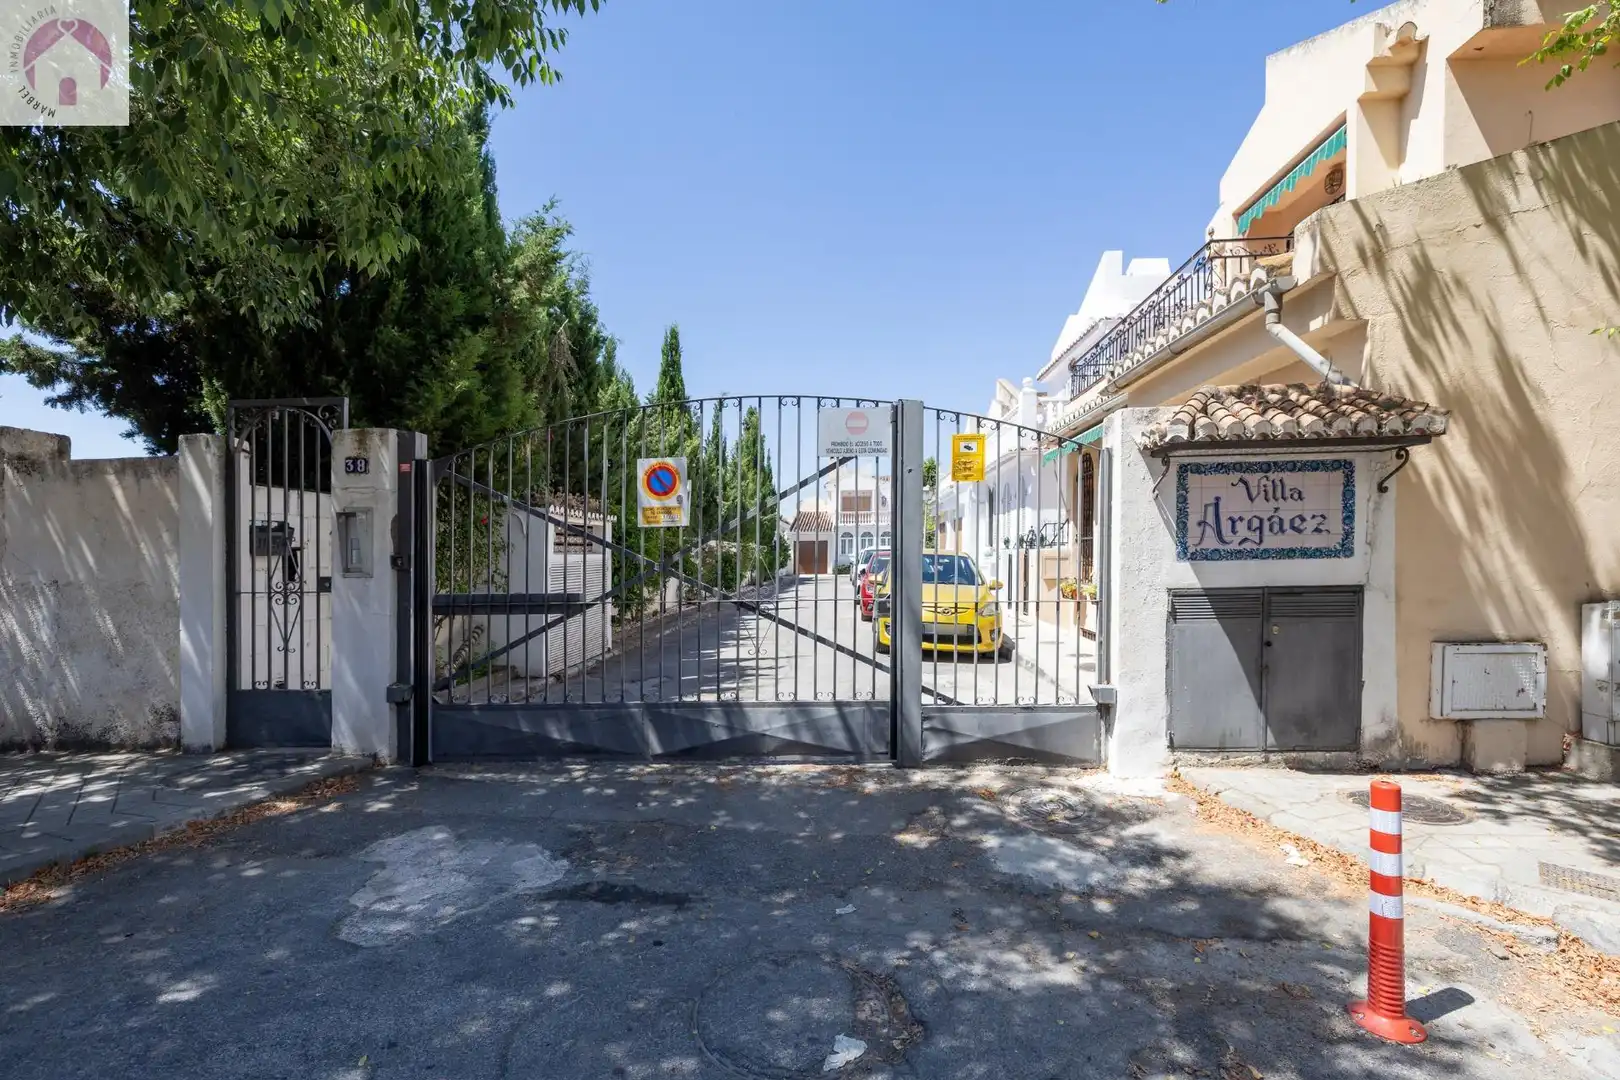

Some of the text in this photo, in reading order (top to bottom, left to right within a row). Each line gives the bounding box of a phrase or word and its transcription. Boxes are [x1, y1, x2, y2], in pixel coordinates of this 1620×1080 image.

[345, 459, 366, 472] 38
[1231, 475, 1305, 504] Villa
[1193, 496, 1331, 547] Argáez
